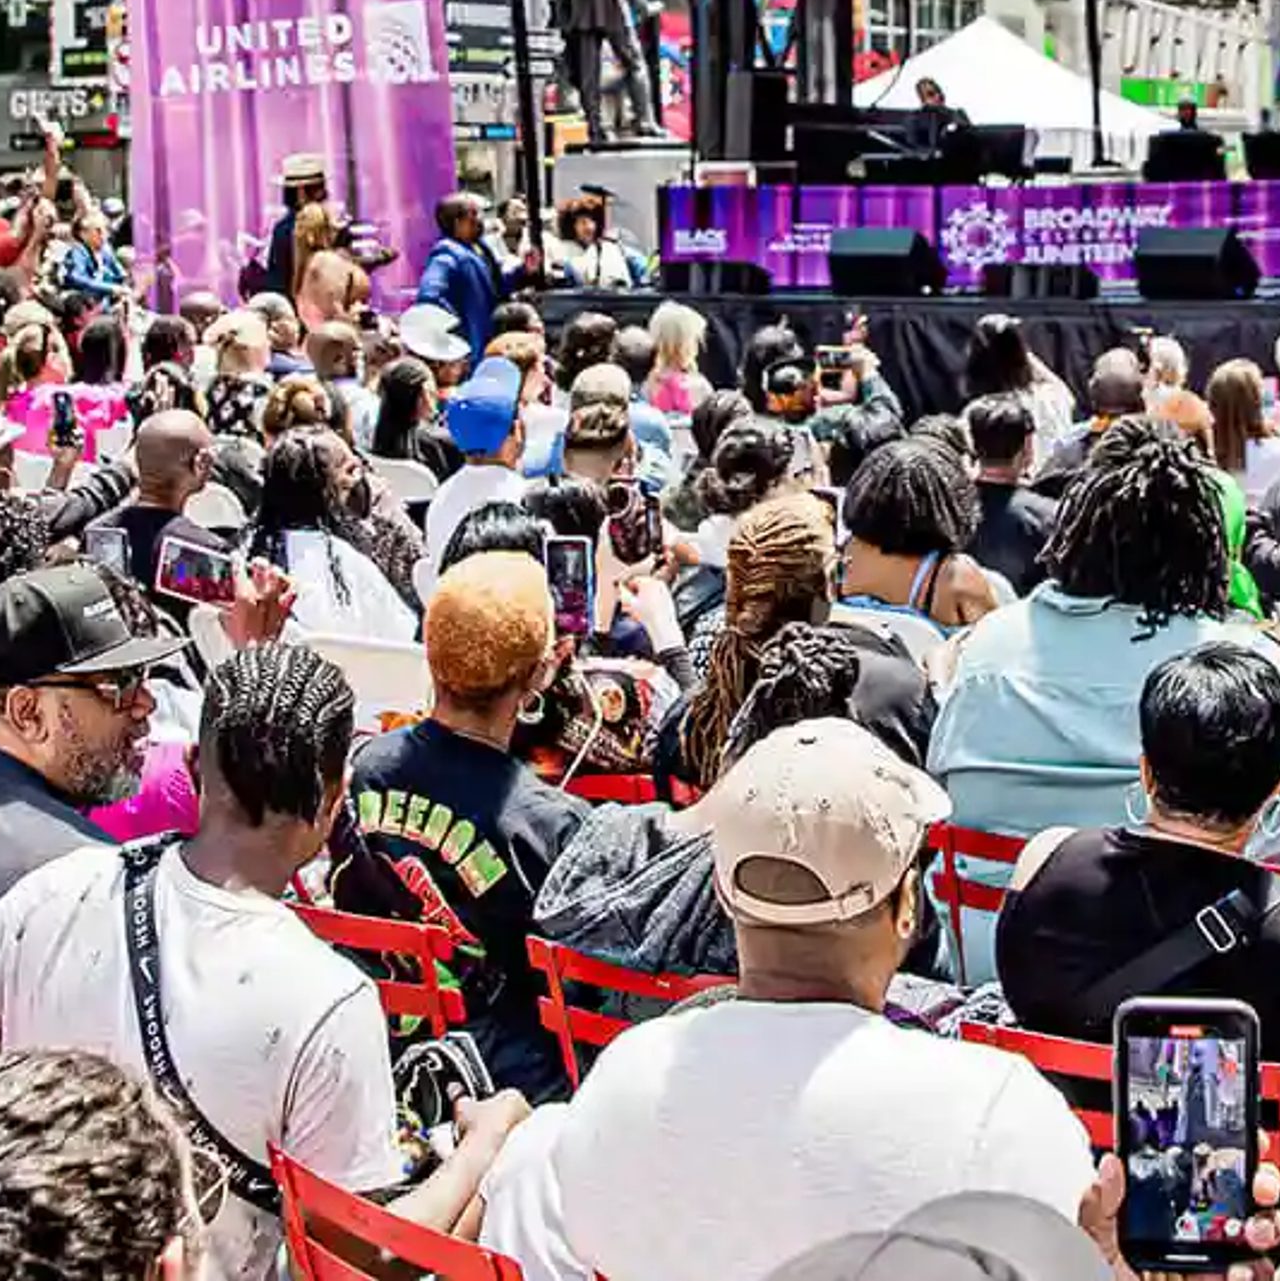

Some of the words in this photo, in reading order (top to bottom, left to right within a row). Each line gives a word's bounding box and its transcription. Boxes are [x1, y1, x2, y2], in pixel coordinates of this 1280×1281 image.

[196, 14, 353, 54] UNITED
[160, 52, 355, 96] AIRLINES
[10, 89, 89, 120] GIFTS
[1023, 203, 1175, 229] BROADWAY
[1021, 242, 1138, 265] JUNETEEN
[358, 788, 509, 899] REEDOM
